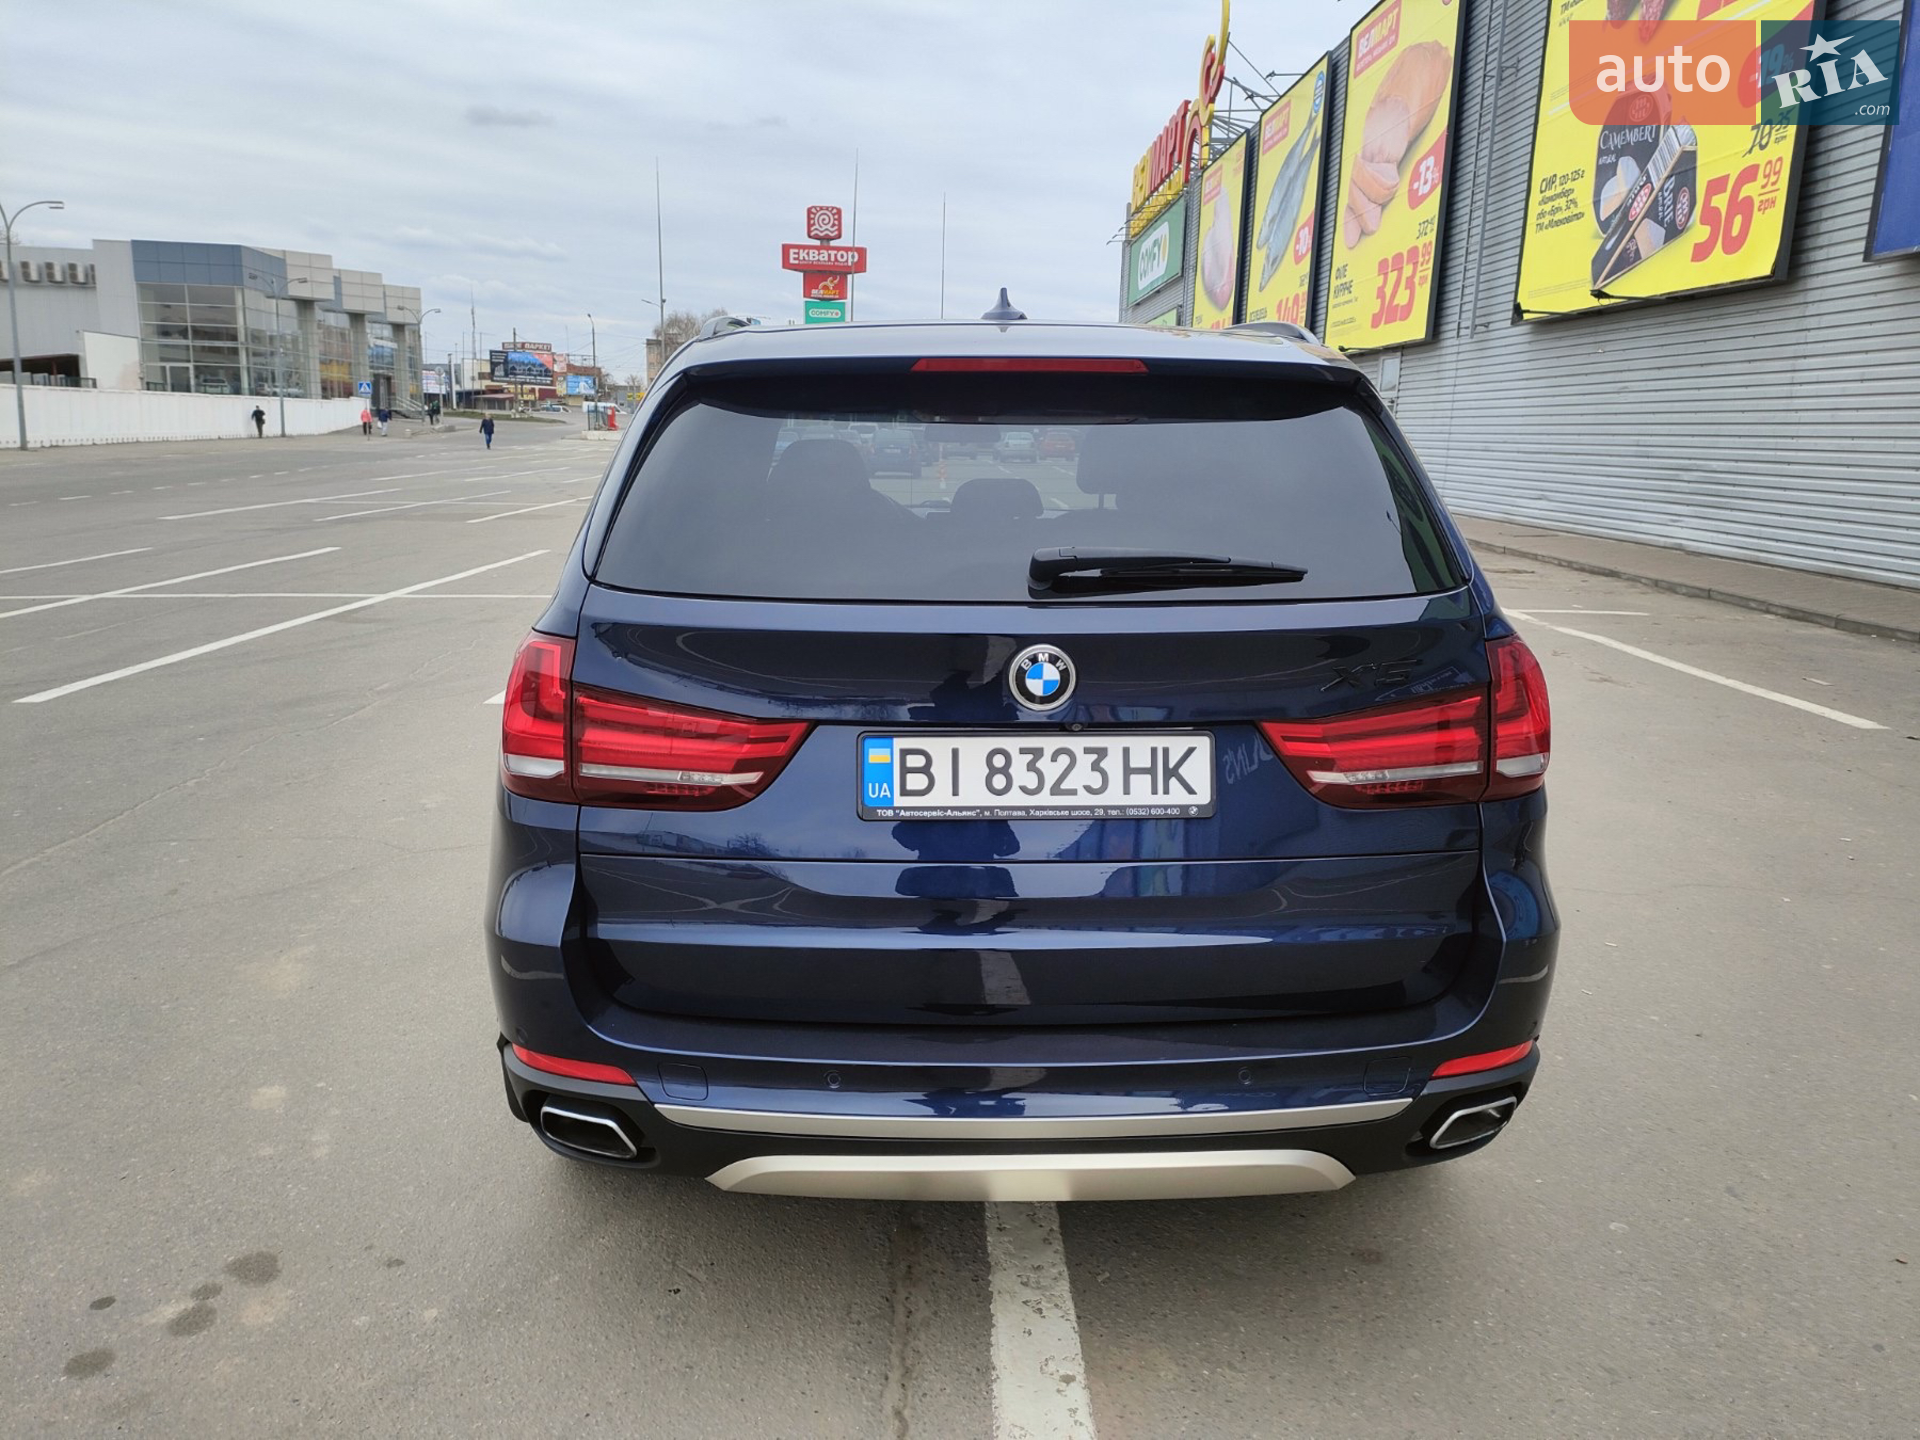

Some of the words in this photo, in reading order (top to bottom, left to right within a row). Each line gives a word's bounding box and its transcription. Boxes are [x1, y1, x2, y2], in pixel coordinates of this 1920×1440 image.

[1599, 123, 1658, 150] CAMEMBERT
[1540, 173, 1557, 194] СИР,
[1690, 163, 1761, 262] 56
[1761, 156, 1784, 189] 99
[1757, 196, 1777, 215] грн
[1371, 245, 1420, 329] 323
[1420, 240, 1433, 267] 99
[1021, 653, 1067, 671] BMW
[899, 747, 960, 797] BI
[985, 747, 1110, 797] 8323
[1122, 746, 1198, 795] HK
[868, 782, 891, 798] UA
[876, 809, 894, 817] ТОВ
[994, 809, 1028, 818] Полтава,
[1029, 808, 1069, 818] Харківське
[1071, 809, 1093, 818] шосе,
[1094, 808, 1106, 817] 29,
[1125, 807, 1150, 817] (0532)
[1150, 807, 1181, 816] 600-400
